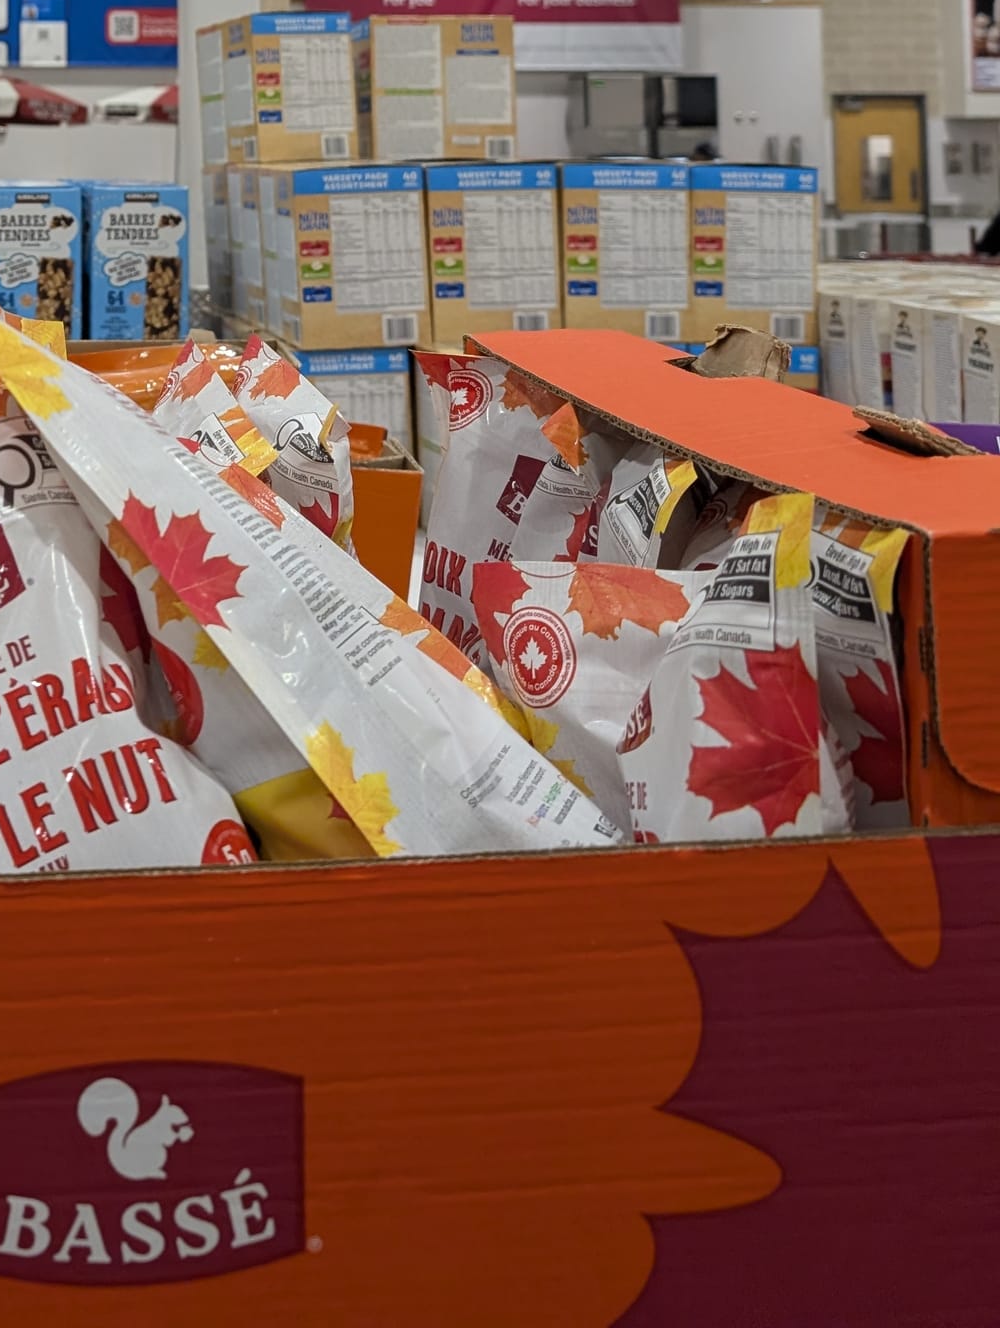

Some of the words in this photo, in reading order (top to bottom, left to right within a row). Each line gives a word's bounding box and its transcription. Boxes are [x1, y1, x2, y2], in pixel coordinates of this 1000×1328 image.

[105, 228, 159, 240] TENDRES
[740, 536, 759, 552] High
[761, 536, 772, 551] in
[423, 541, 466, 597] OIX
[721, 582, 754, 598] Sugars
[540, 627, 560, 660] Canada
[715, 628, 752, 644] Canada
[5, 635, 36, 668] DE
[534, 664, 557, 691] Canada
[62, 737, 178, 833] NUT
